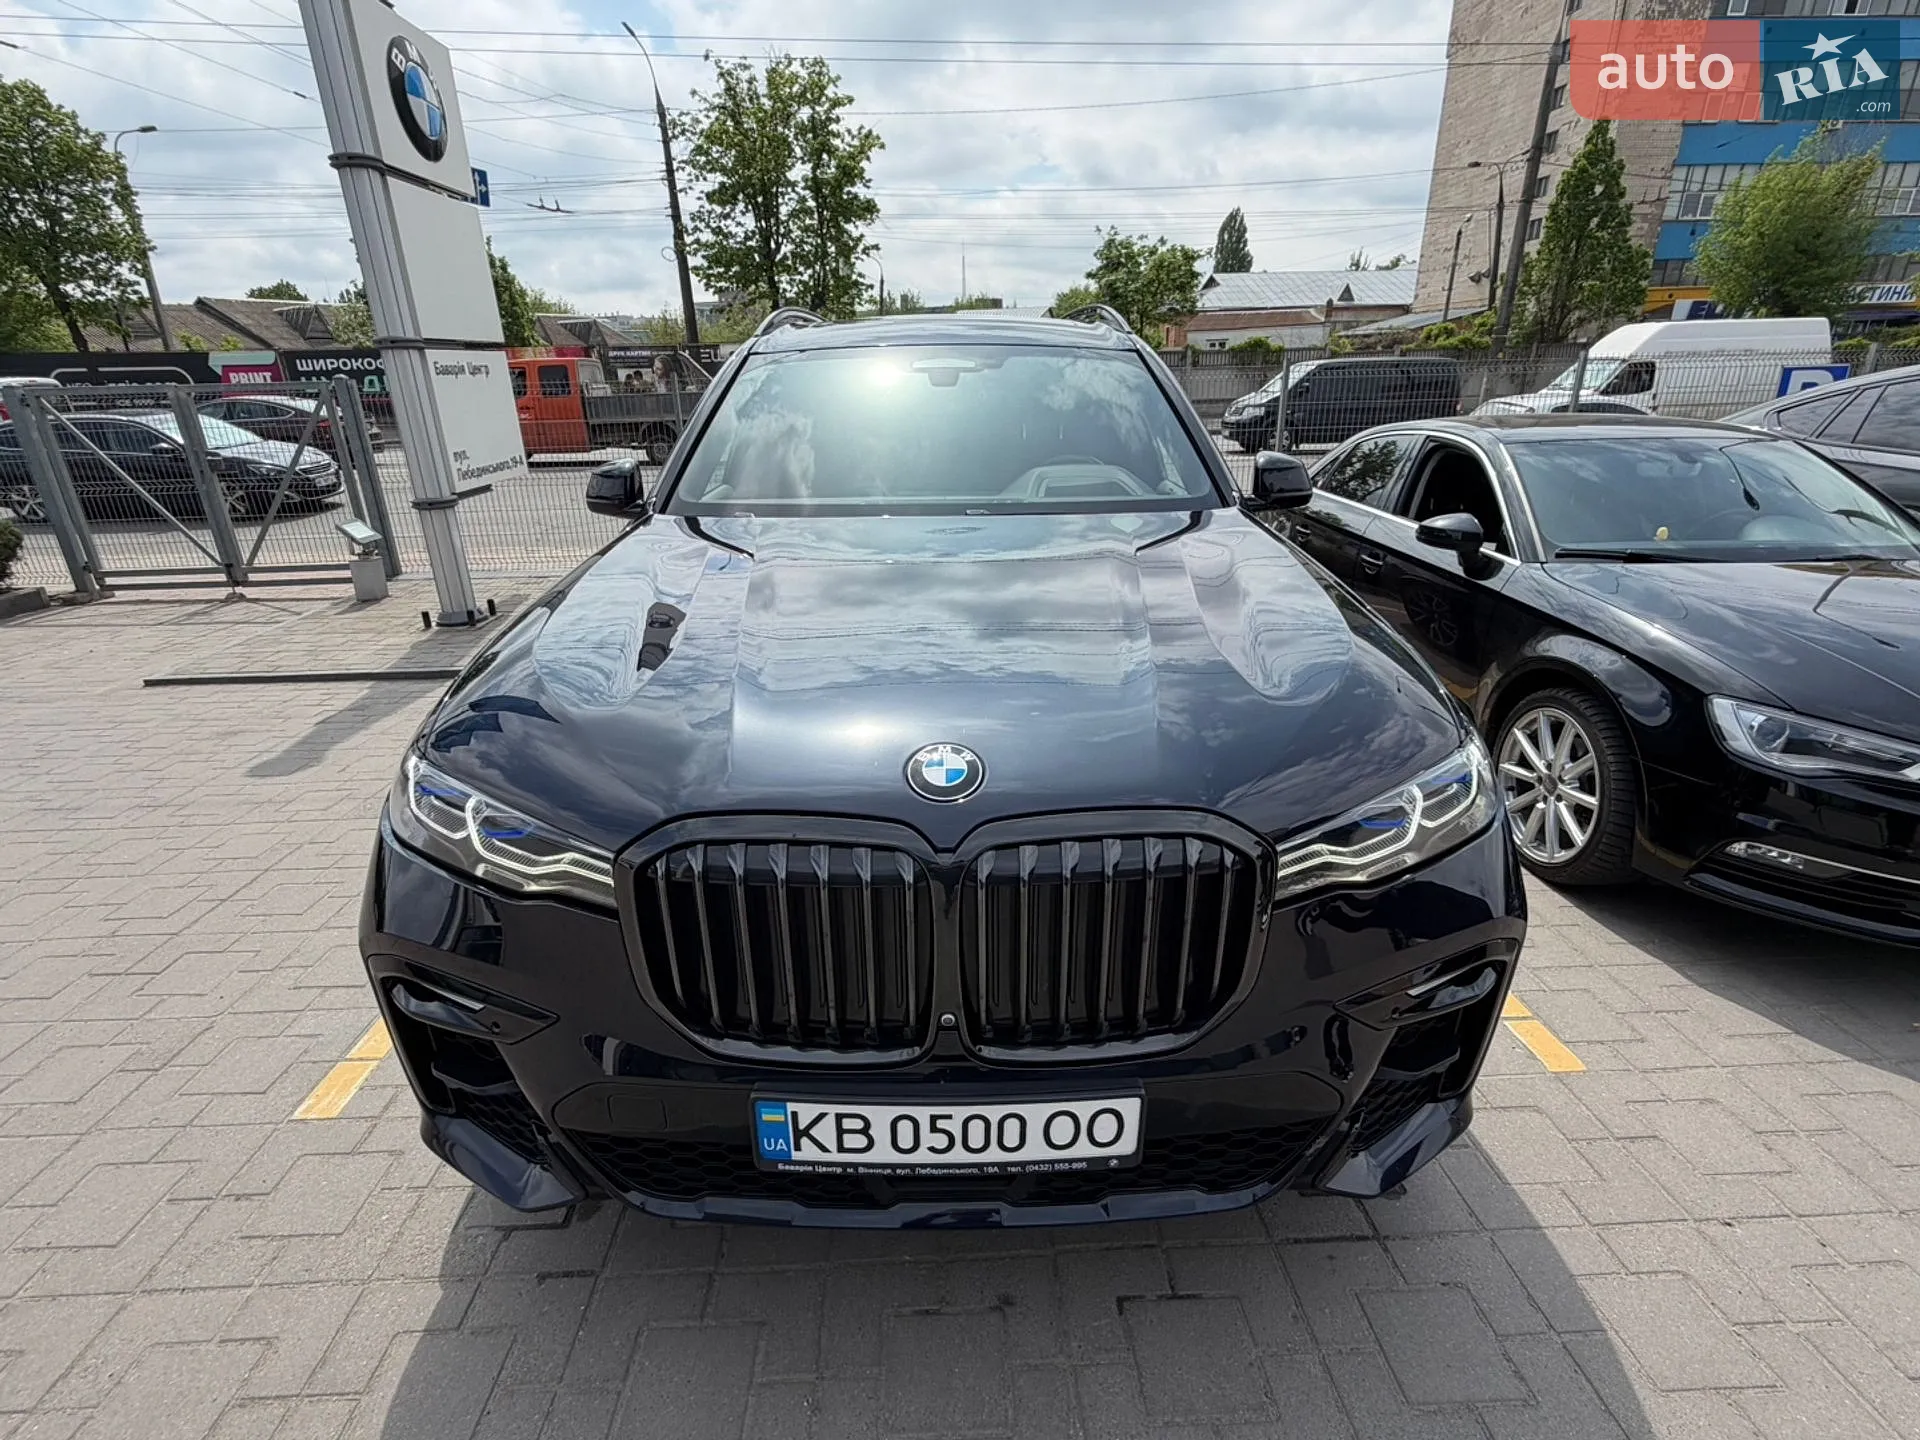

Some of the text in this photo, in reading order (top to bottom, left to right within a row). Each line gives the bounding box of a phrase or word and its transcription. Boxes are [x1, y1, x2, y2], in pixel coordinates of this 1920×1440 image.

[433, 361, 490, 379] Баварія Центр
[790, 1107, 1125, 1155] KB 0500 OO
[763, 1138, 788, 1151] UA
